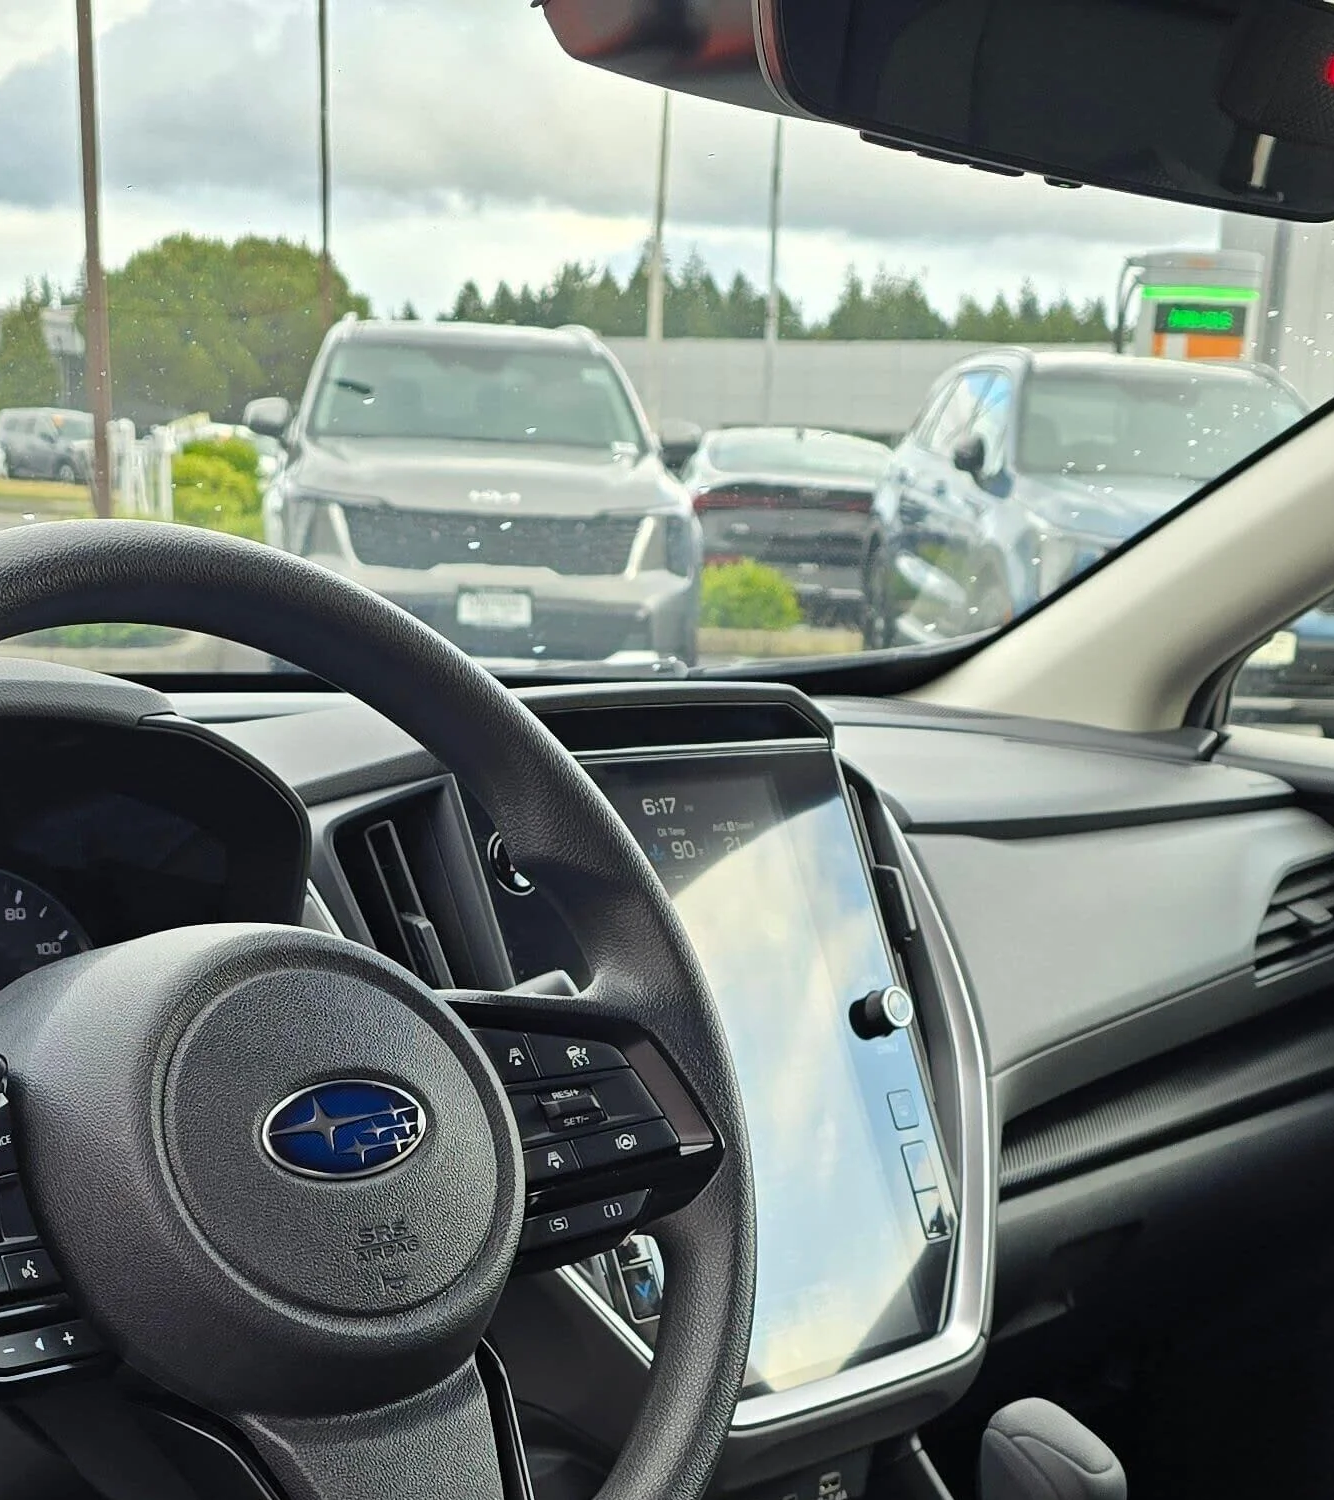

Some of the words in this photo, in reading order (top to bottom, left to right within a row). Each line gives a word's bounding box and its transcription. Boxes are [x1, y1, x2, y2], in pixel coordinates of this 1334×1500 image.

[641, 797, 676, 816] 6:17
[671, 840, 696, 860] 90
[4, 907, 27, 921] 80
[35, 941, 63, 956] 100
[357, 1220, 407, 1243] SRS
